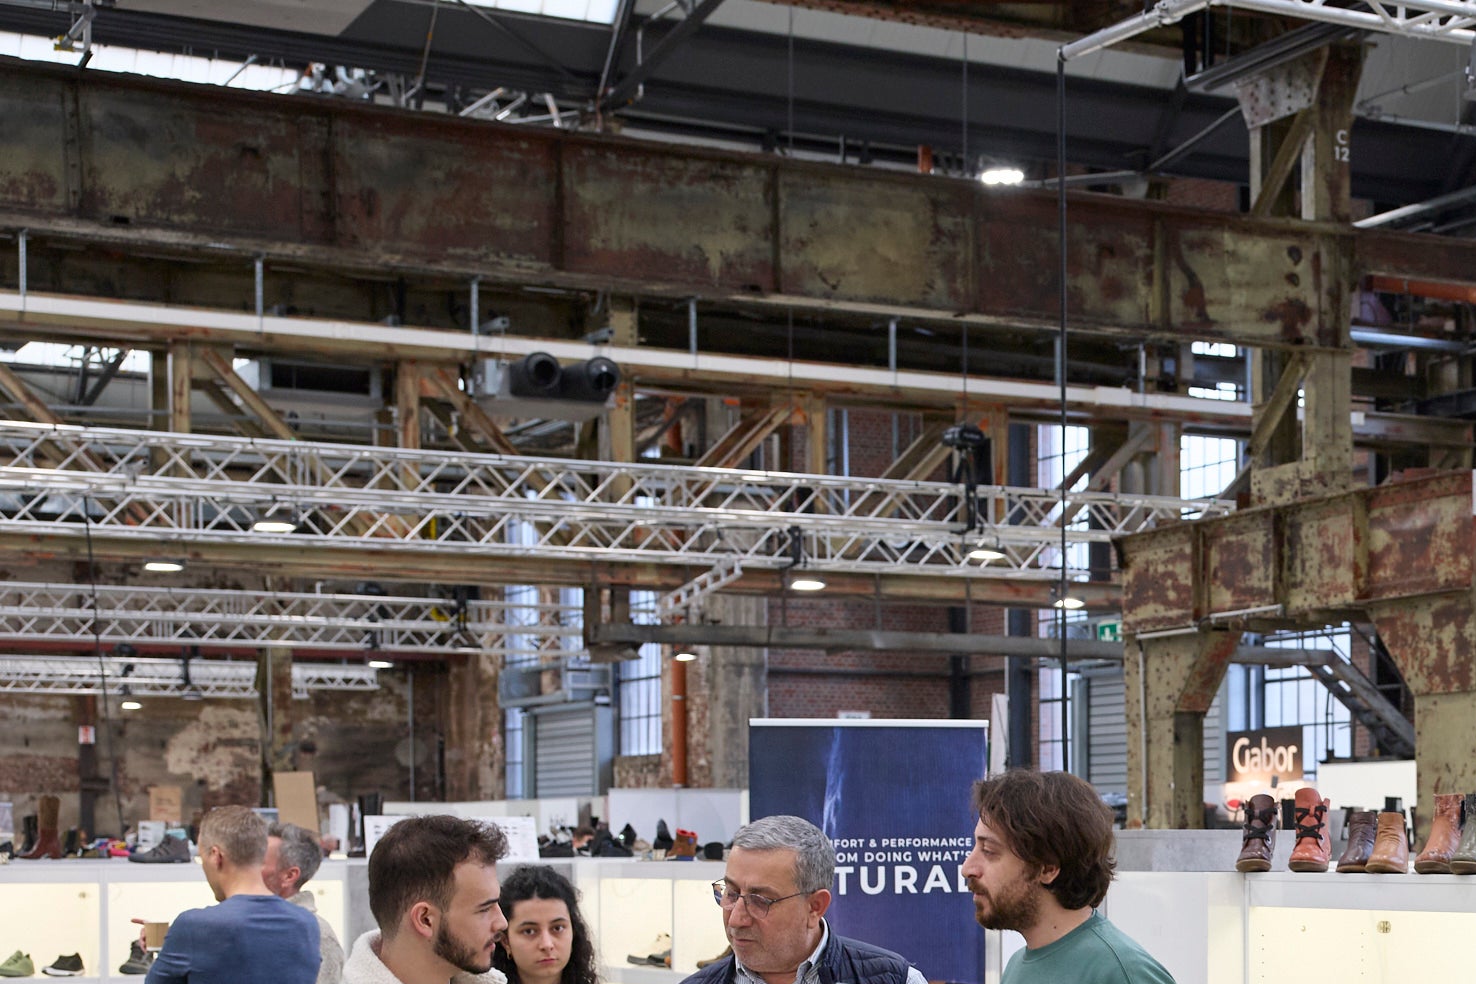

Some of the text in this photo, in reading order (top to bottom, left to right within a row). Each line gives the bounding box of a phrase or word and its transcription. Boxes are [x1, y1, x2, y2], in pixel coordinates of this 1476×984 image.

[1336, 129, 1348, 145] C
[1334, 146, 1350, 162] 12
[1232, 736, 1298, 773] Gabor
[829, 837, 972, 848] FORT & PERFORMANCE
[864, 851, 913, 862] DOING
